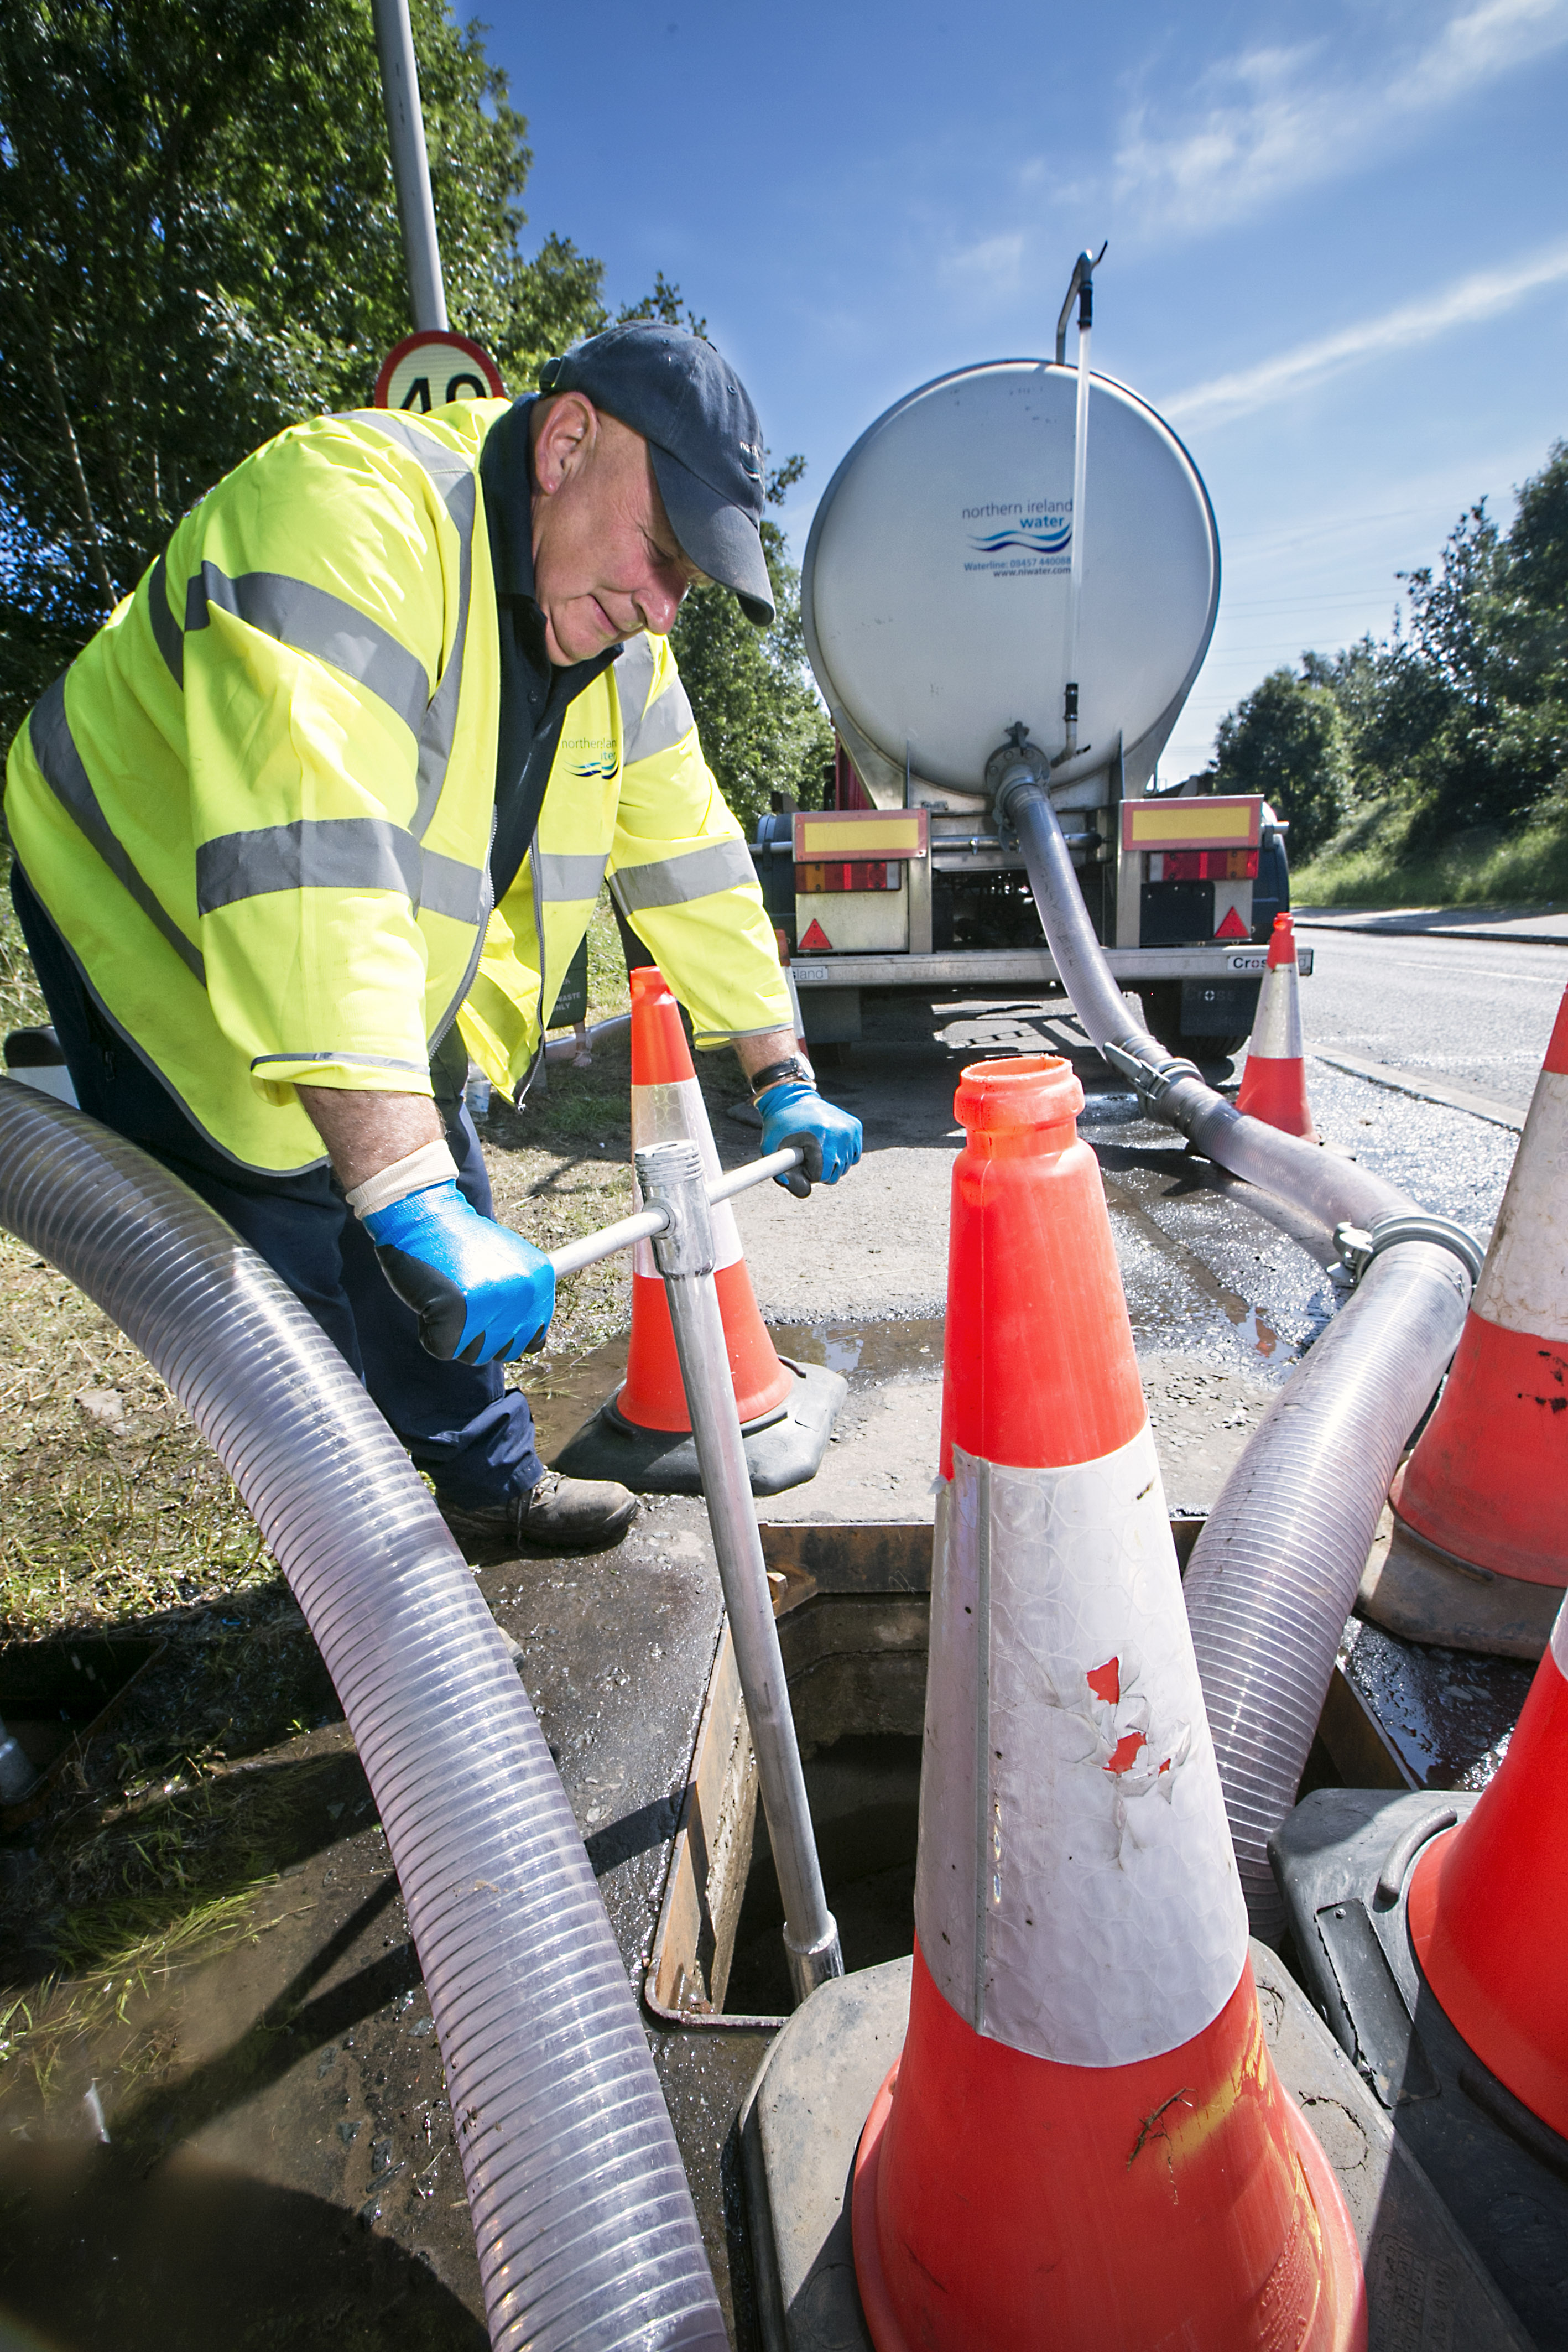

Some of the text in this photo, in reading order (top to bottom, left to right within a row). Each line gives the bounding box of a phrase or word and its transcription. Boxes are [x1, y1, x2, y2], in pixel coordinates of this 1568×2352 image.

[962, 498, 1072, 518] northern ireland
[1019, 516, 1064, 528] water
[963, 560, 1009, 571] Waterline:
[993, 566, 1071, 577] www.niwater.com
